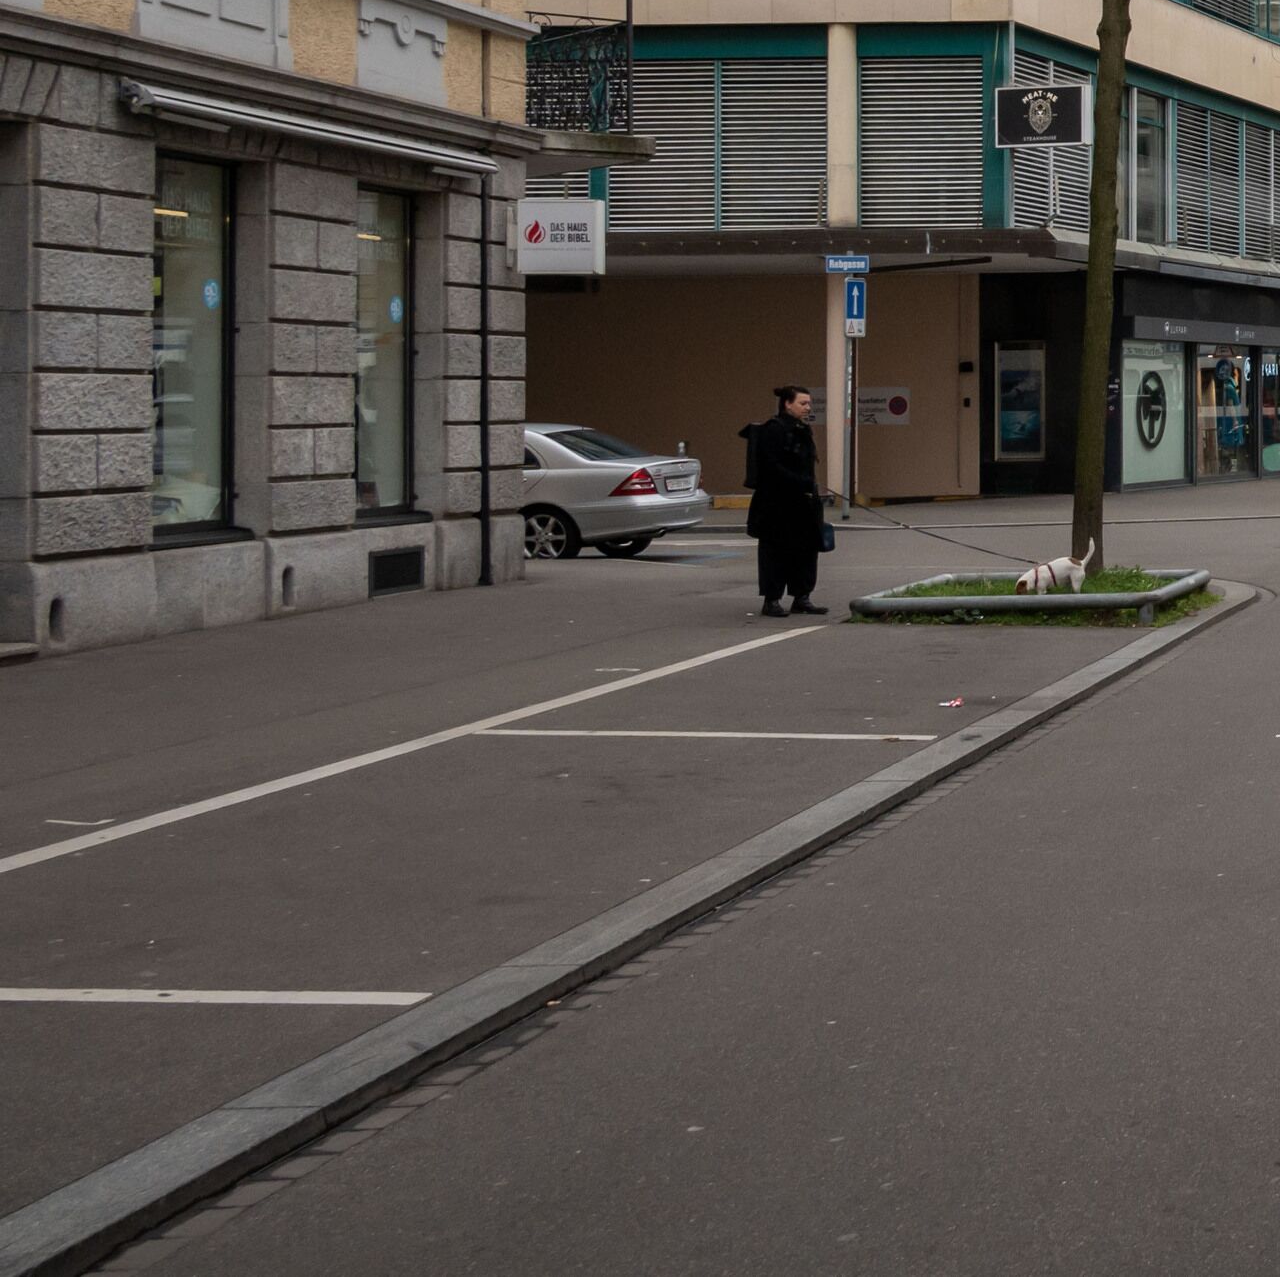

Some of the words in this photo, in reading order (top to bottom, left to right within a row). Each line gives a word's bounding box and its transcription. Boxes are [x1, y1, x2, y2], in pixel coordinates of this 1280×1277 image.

[1021, 90, 1043, 104] MEAT
[550, 222, 565, 232] DAS
[567, 222, 588, 232] HAUS
[550, 233, 565, 243] DER
[567, 233, 591, 243] BIBEL
